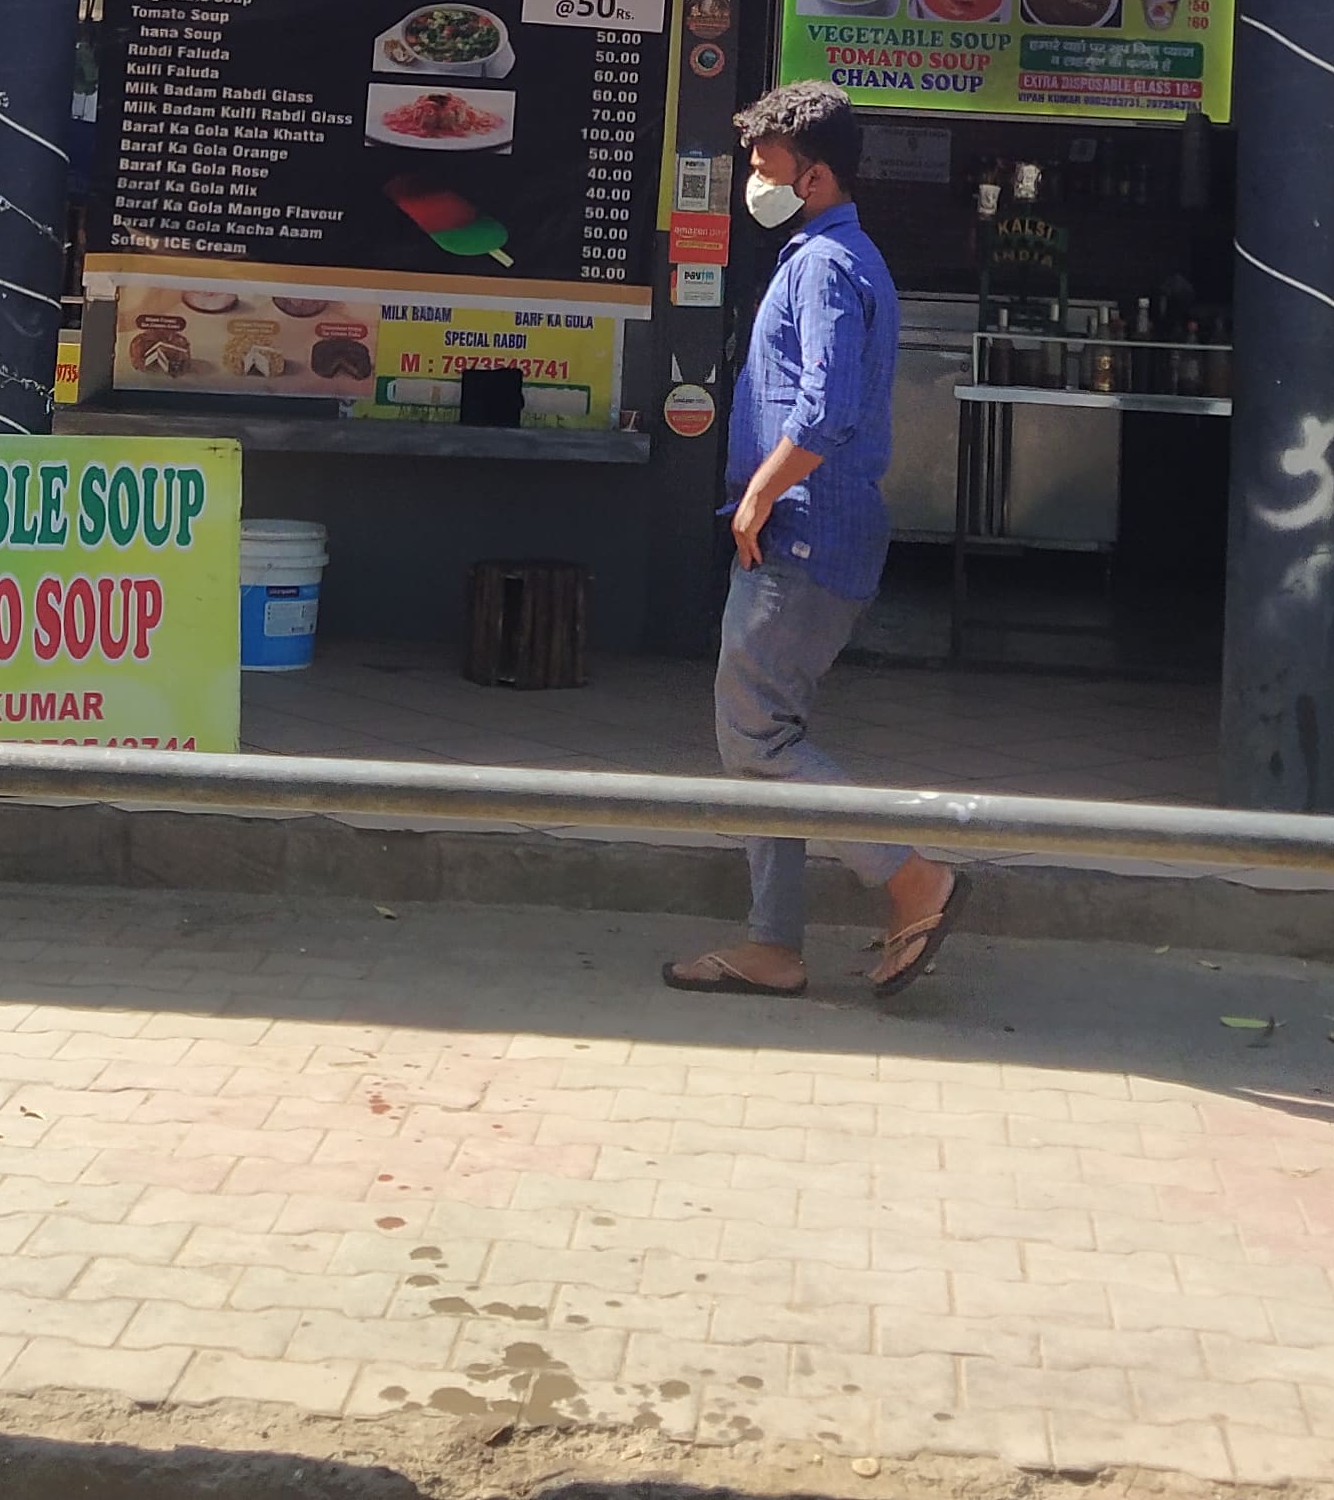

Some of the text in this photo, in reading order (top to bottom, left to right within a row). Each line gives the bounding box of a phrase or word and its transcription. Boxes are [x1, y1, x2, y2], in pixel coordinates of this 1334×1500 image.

[131, 6, 230, 23] Tomato Soup
[807, 24, 943, 48] VEGETABLE
[949, 32, 1012, 51] SOUP
[177, 47, 230, 61] Faluda
[826, 46, 991, 72] TOMATO SOUP
[126, 62, 219, 79] Kulfi Faluda
[831, 69, 983, 93] CHANA SOUP
[1024, 76, 1171, 95] EXTRA DISPOSABLE GLASS
[125, 82, 314, 104] Milk Badam Rabdi Glass
[591, 109, 636, 123] 70.00
[580, 128, 635, 143] 100.00
[116, 196, 344, 221] Baraf Ka Gola Mango Flavour
[581, 266, 625, 281] 30.00
[381, 305, 544, 327] MILK BADAM BARF
[444, 331, 527, 349] SPECIAL RABDI
[78, 464, 206, 548] SOUP
[33, 577, 163, 662] SOUP
